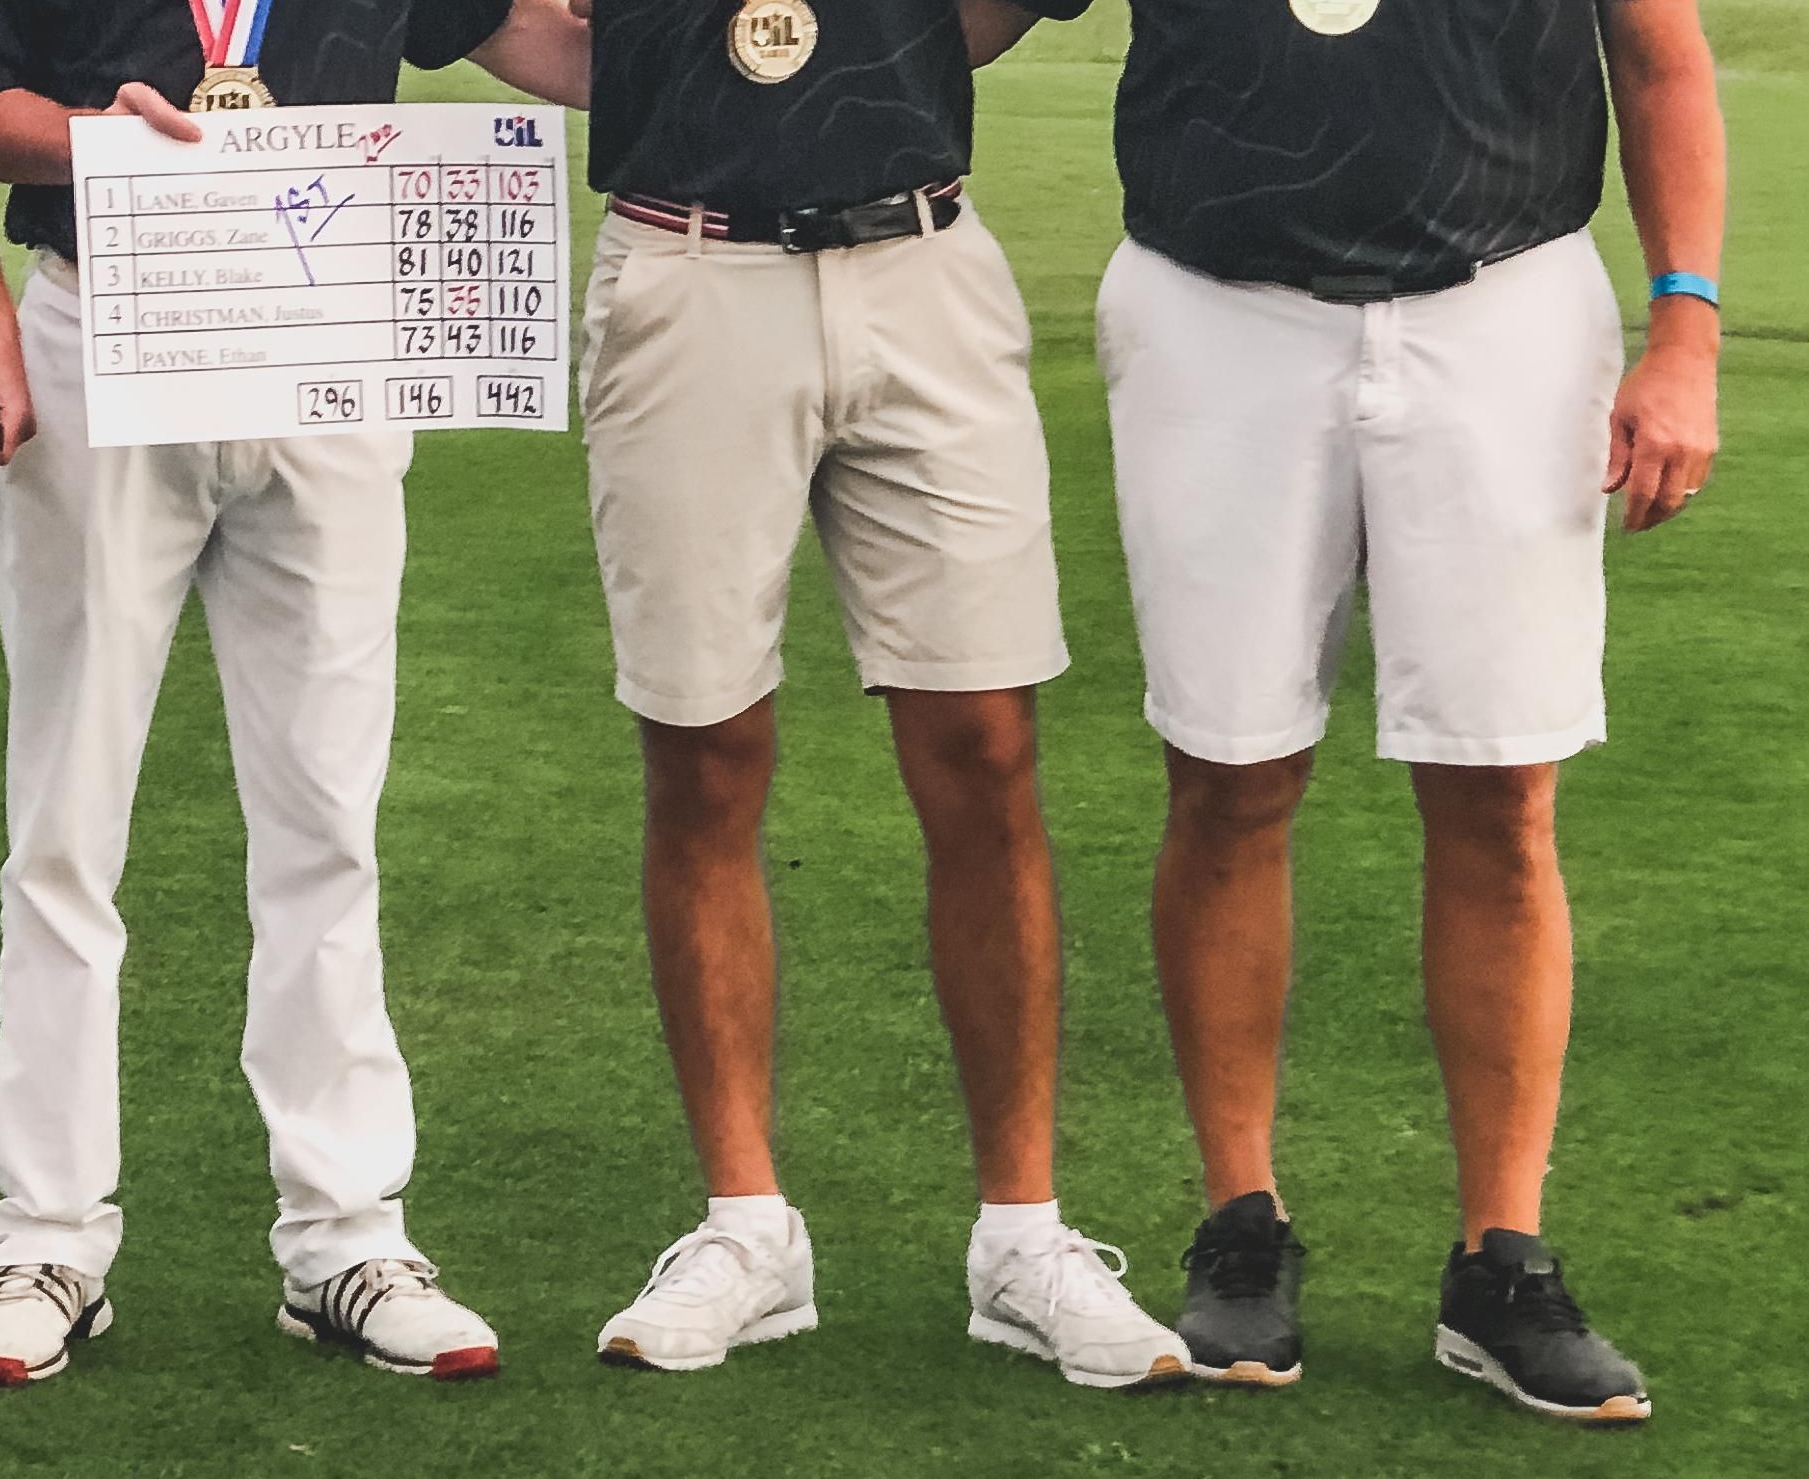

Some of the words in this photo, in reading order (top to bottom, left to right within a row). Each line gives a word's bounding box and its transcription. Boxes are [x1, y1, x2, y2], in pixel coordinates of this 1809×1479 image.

[219, 123, 356, 153] ARGYLE
[106, 188, 114, 209] 1
[397, 171, 432, 200] 70
[446, 170, 480, 200] 33
[498, 170, 539, 202] 103
[106, 227, 119, 247] 2
[226, 228, 269, 245] Zane
[398, 210, 432, 239] 78
[445, 210, 479, 242] 38
[501, 210, 535, 239] 116
[107, 265, 119, 287] 3
[215, 268, 263, 284] Blake
[398, 247, 427, 276] 81
[447, 248, 482, 277] 40
[498, 248, 534, 278] 121
[109, 304, 122, 324] 4
[400, 288, 434, 316] 75
[447, 286, 481, 315] 35
[499, 286, 541, 316] 110
[401, 325, 435, 354] 73
[448, 325, 482, 354] 43
[500, 326, 535, 354] 116
[111, 344, 122, 365] 5
[219, 348, 267, 364] Ethan
[308, 386, 355, 418] 296
[399, 383, 442, 414] 146
[487, 383, 536, 414] 442
